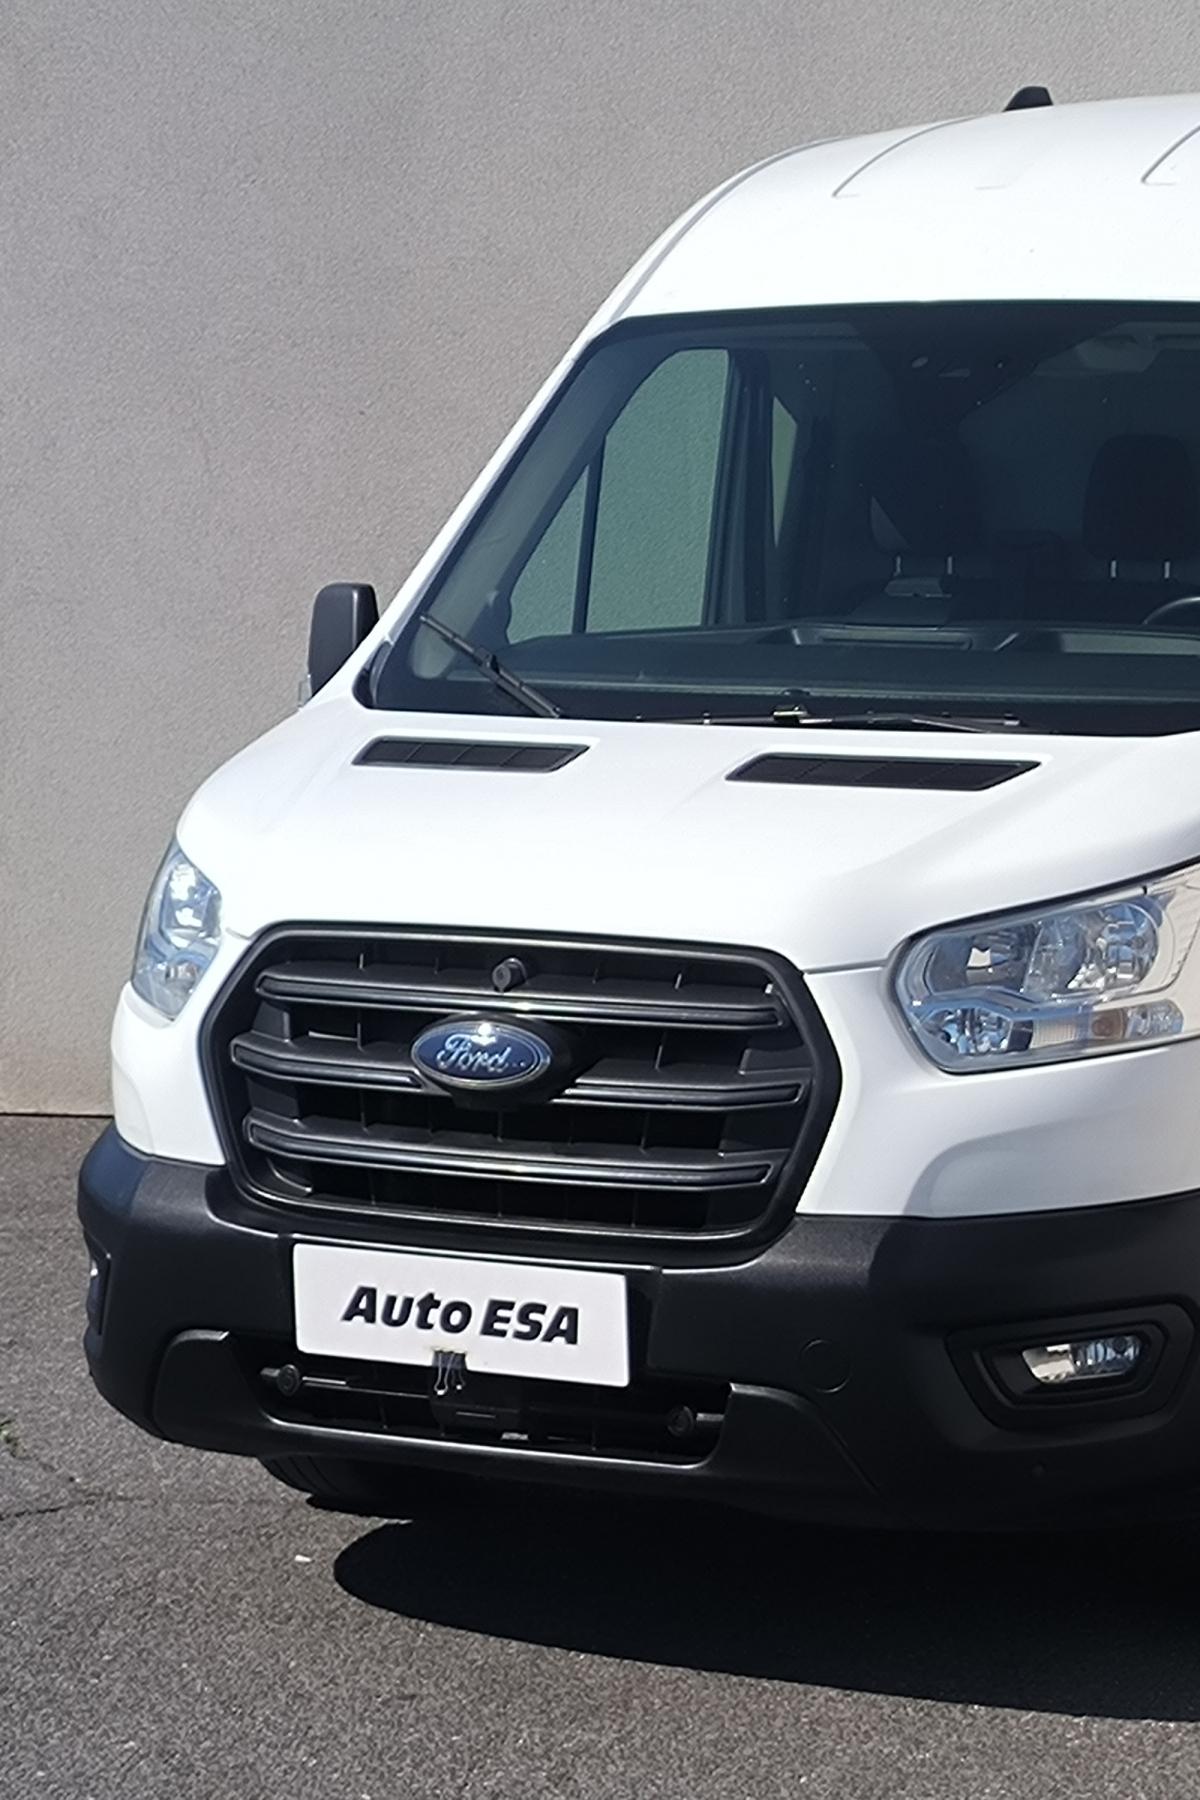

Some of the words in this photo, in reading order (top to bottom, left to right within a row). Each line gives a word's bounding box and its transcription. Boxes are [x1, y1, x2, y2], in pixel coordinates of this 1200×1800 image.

[437, 1033, 514, 1071] Ford
[342, 1286, 472, 1334] Auto
[480, 1299, 579, 1345] ESA
